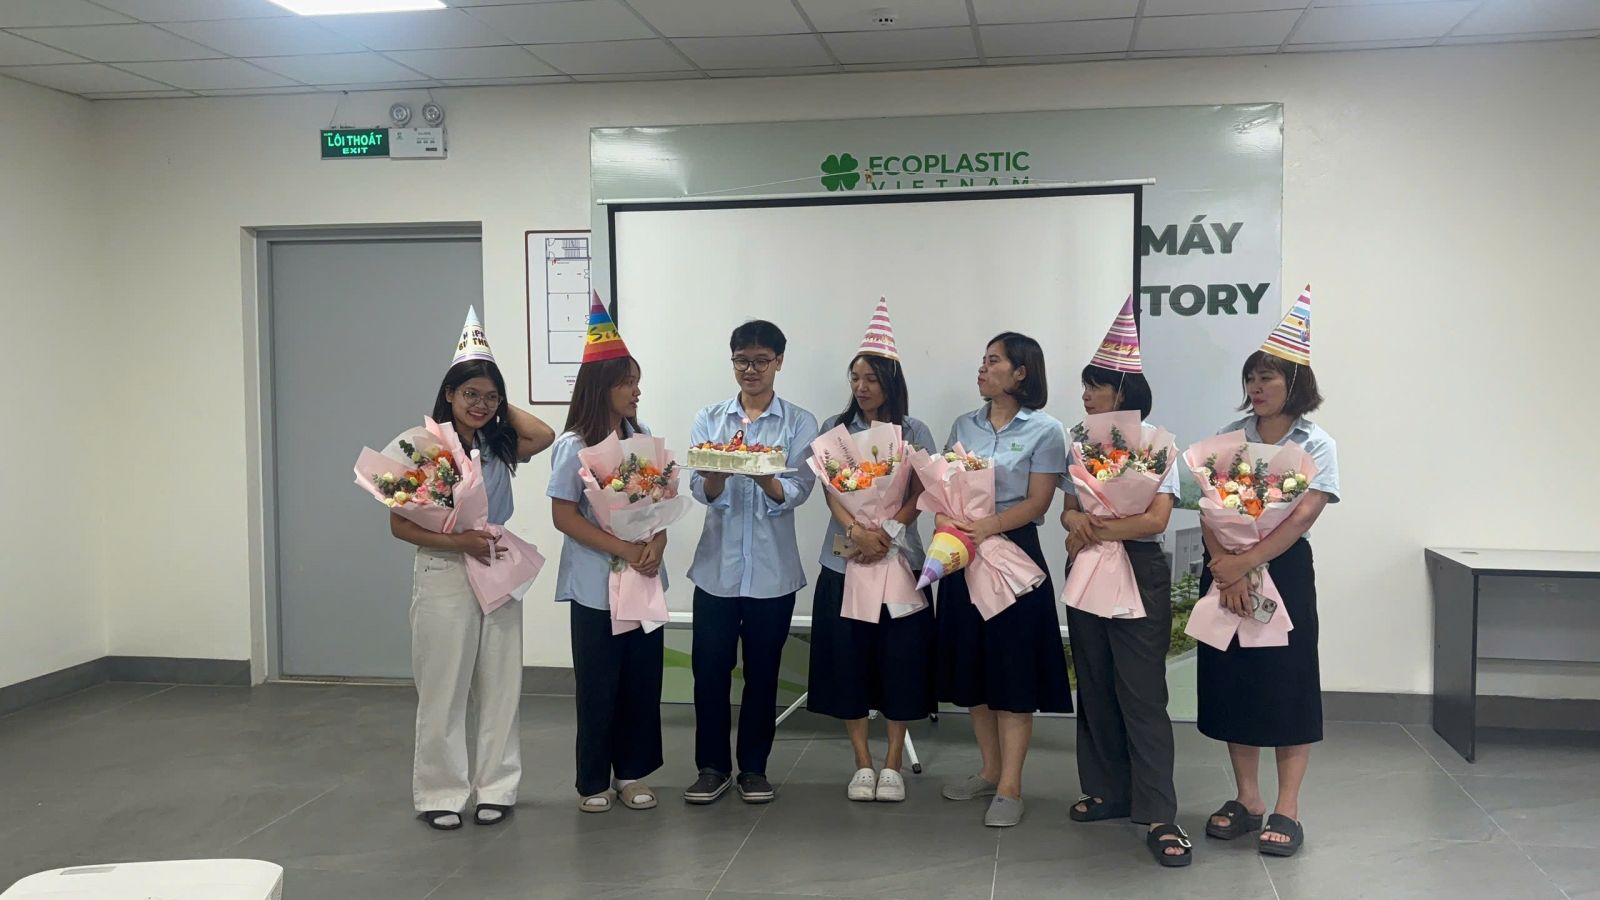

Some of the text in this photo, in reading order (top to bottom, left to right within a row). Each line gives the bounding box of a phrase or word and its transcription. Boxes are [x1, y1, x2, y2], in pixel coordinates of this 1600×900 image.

[346, 132, 383, 146] THOÁT
[869, 151, 1030, 175] ECOPLASTIC
[1141, 214, 1244, 256] MÁY
[1140, 282, 1271, 317] TORY
